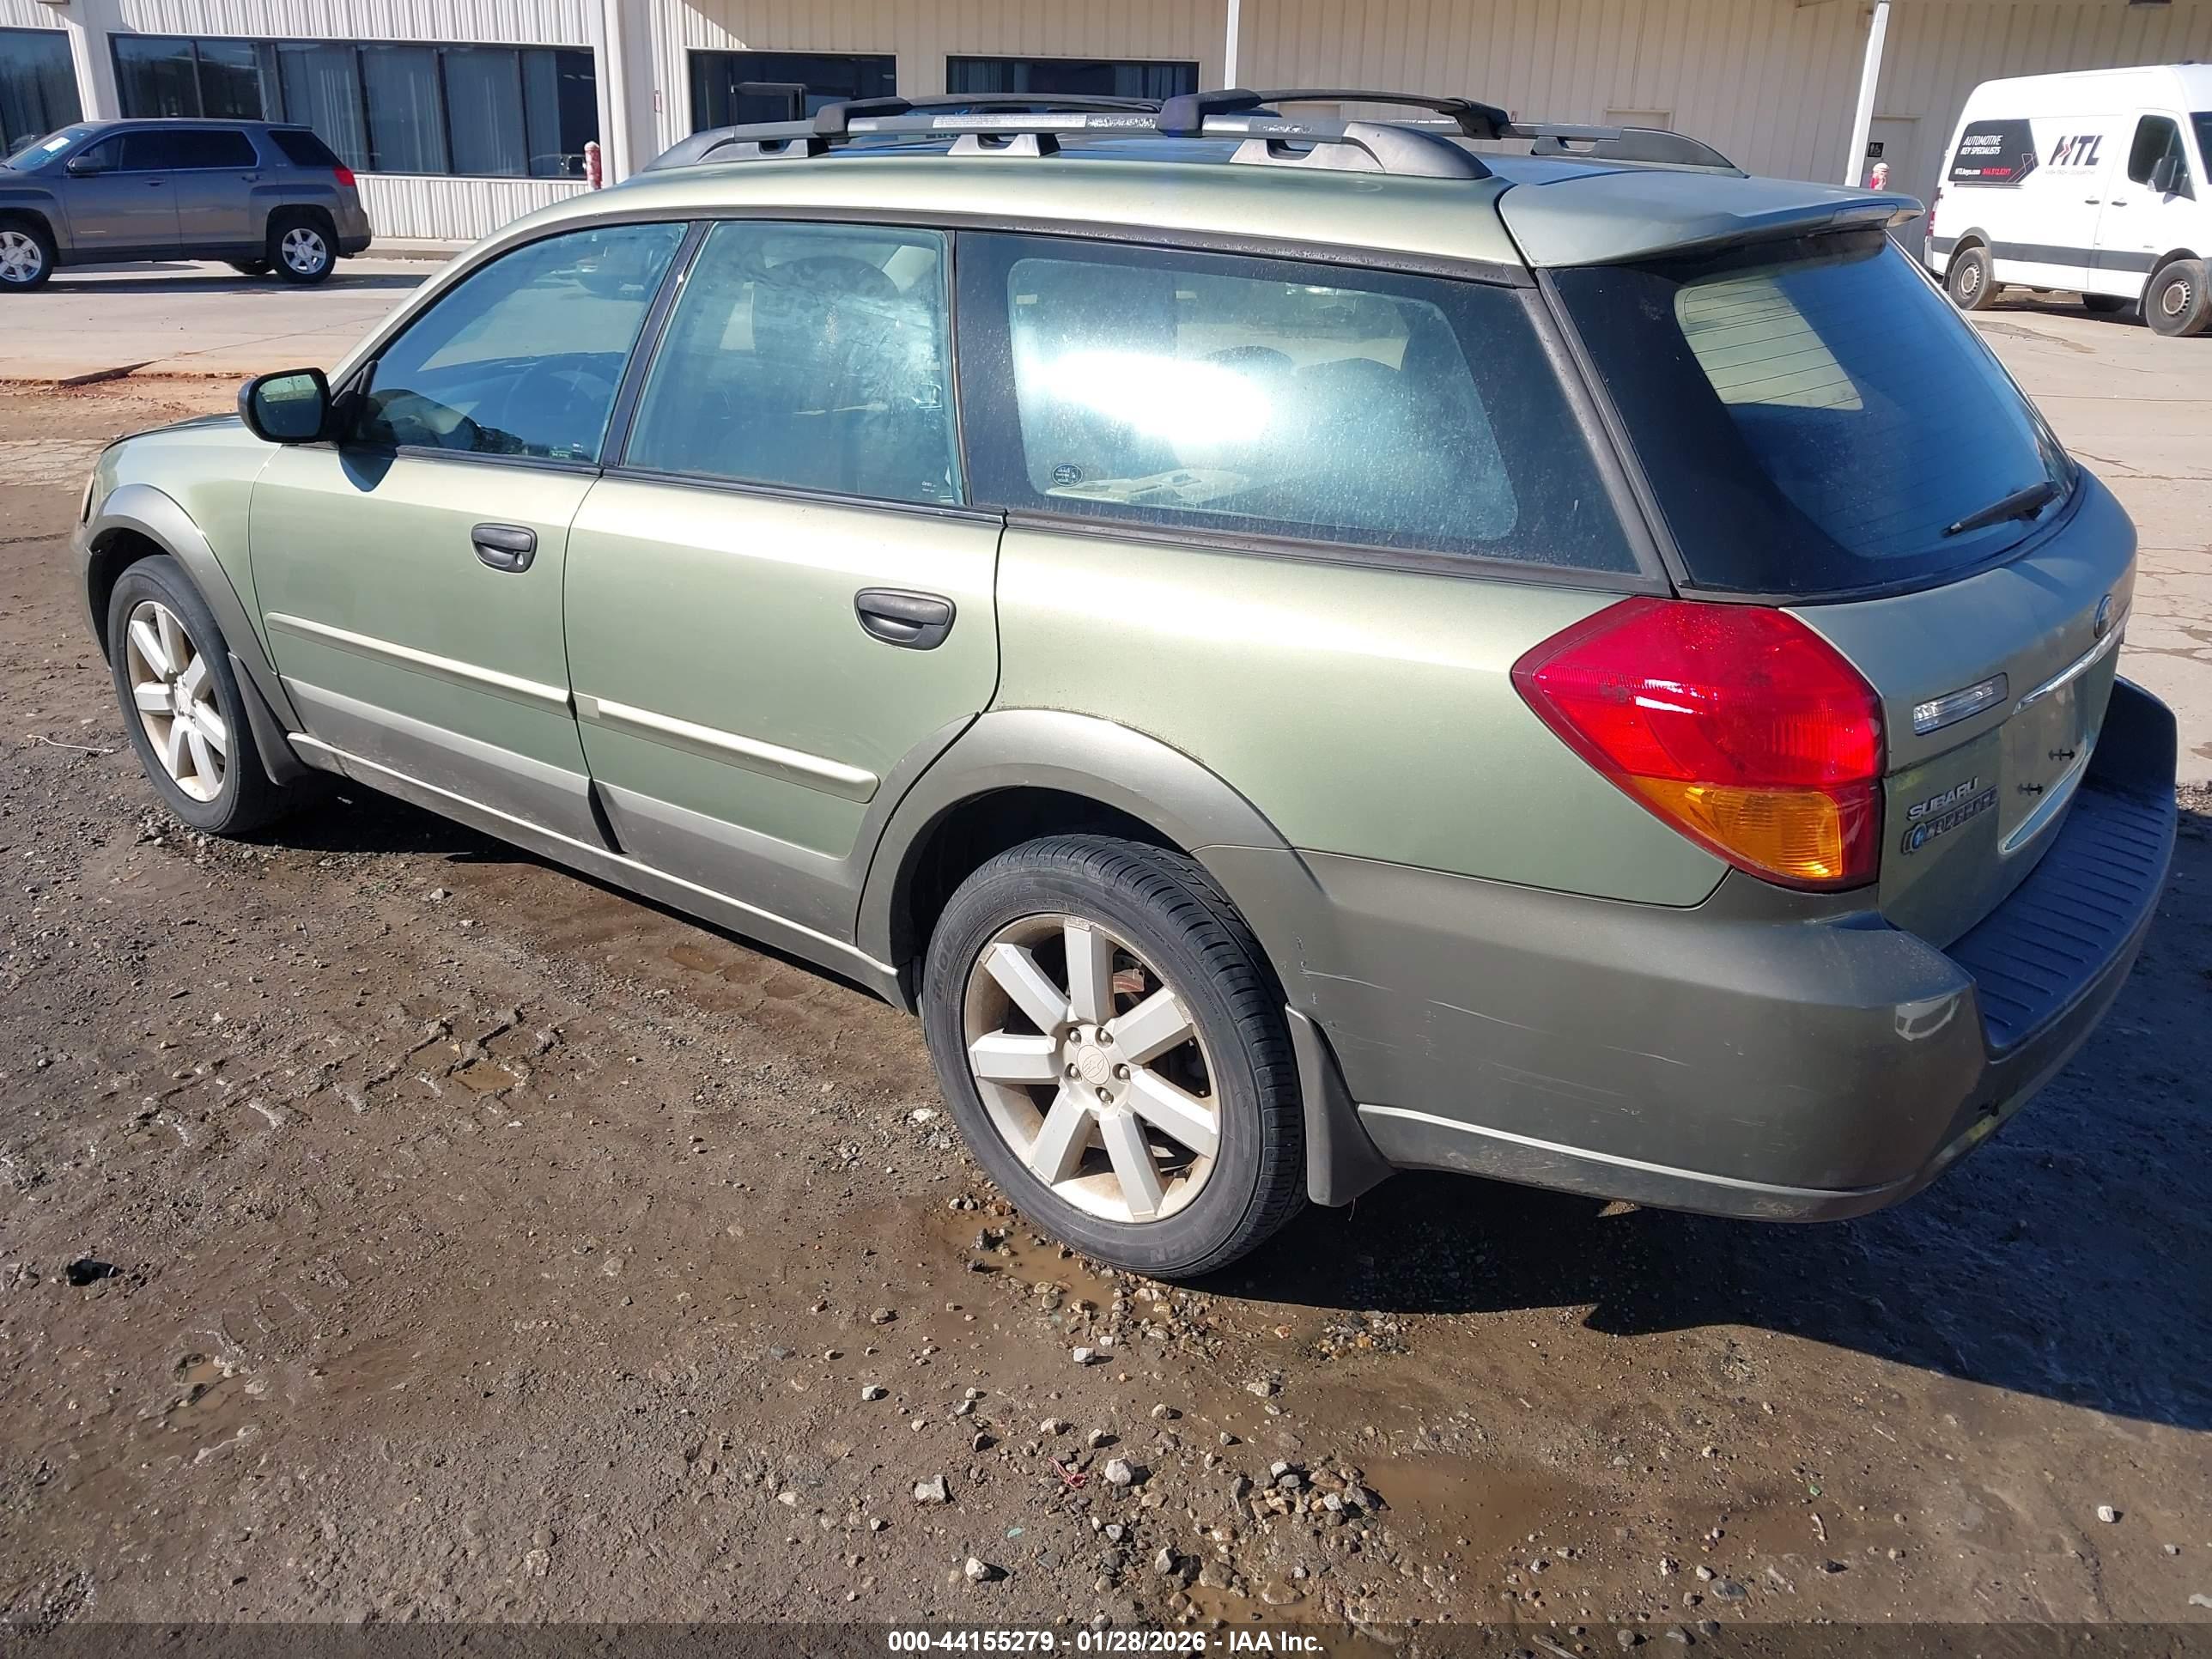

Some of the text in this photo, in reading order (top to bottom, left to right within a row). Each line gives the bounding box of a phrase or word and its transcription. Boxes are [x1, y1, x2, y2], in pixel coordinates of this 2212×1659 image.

[1963, 135, 2003, 145] AUTOMOTIVE
[1960, 146, 2002, 155] KEY SPECIALISTS
[1907, 776, 1979, 820] SUBARU
